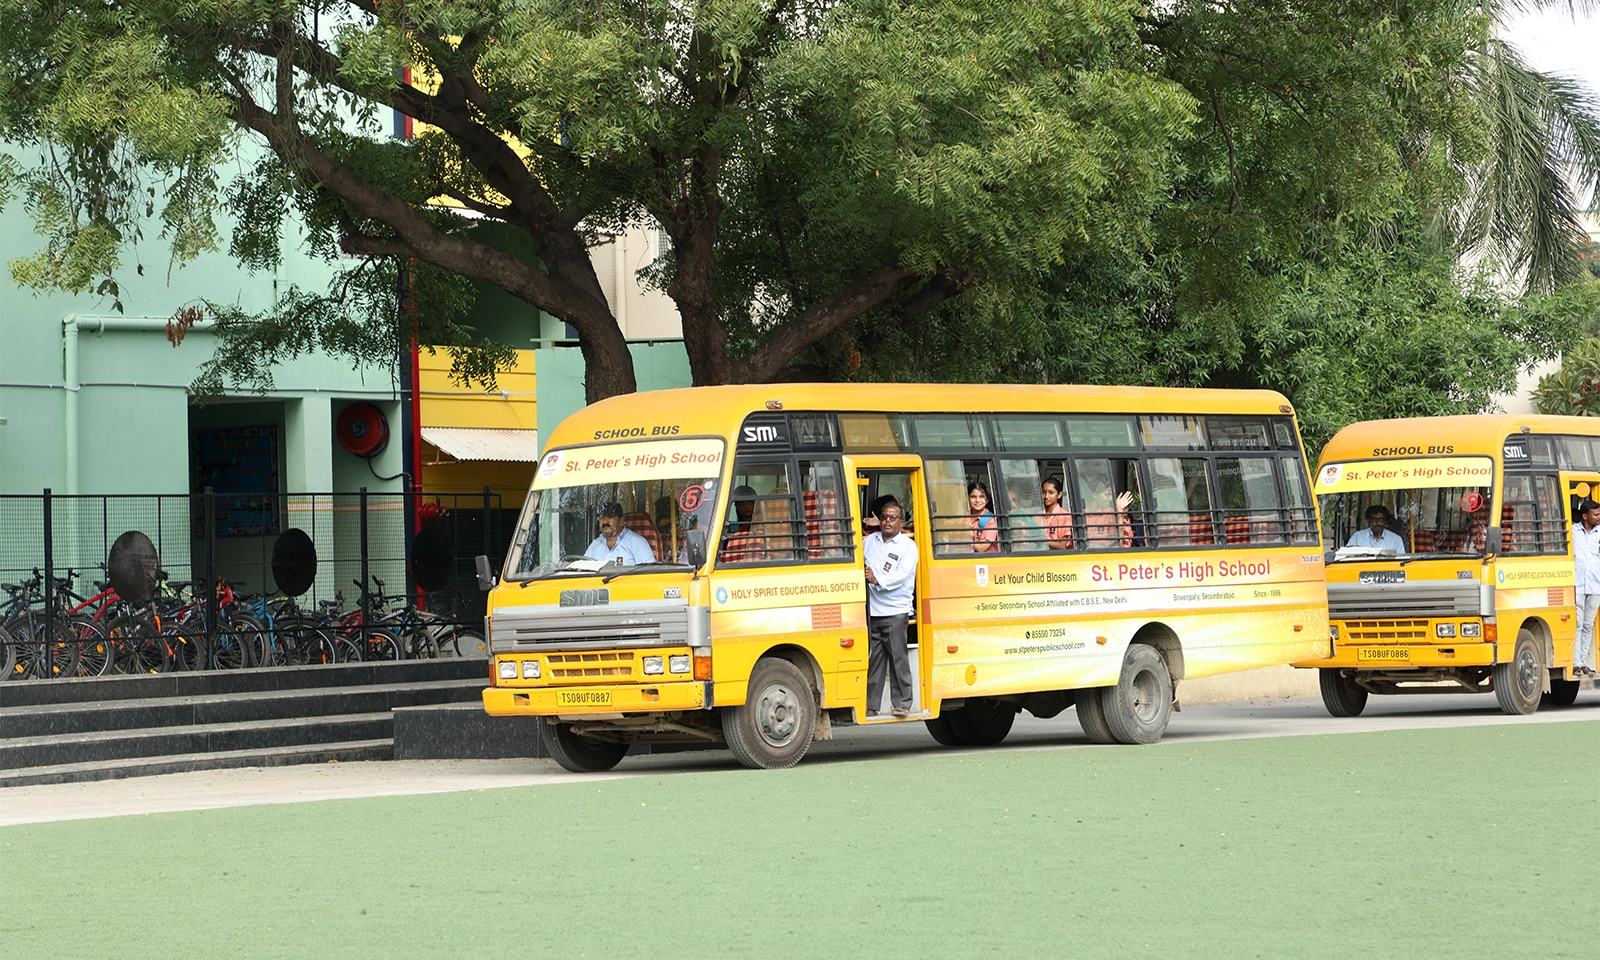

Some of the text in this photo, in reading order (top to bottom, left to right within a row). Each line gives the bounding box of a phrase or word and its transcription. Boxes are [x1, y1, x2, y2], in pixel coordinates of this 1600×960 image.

[594, 426, 680, 440] SCHOOL BUS
[1372, 446, 1454, 456] SCHOOL BUS
[1504, 446, 1528, 458] SML
[565, 460, 582, 472] St.
[635, 454, 666, 468] High
[670, 452, 720, 464] School
[1346, 472, 1362, 481] St.
[1414, 468, 1442, 478] High
[1446, 466, 1492, 476] School
[684, 490, 698, 508] 5
[1467, 495, 1478, 508] 9
[1092, 564, 1112, 582] St.
[1179, 562, 1214, 582] High
[1218, 558, 1270, 576] School
[1518, 572, 1530, 580] SPIRIT
[1531, 571, 1556, 580] EDUCATIONAL
[994, 574, 1006, 584] Let
[1008, 574, 1024, 584] Your
[1026, 572, 1044, 584] Child
[1046, 572, 1077, 582] Blossom
[730, 582, 860, 599] HOLY SPIRIT EDUCATIONAL SOCIETY
[560, 589, 610, 608] SML
[981, 602, 998, 610] Senior
[999, 602, 1026, 610] Secondary
[1028, 600, 1046, 608] School
[1004, 642, 1086, 655] www.stpeterspublicschool.com
[1364, 650, 1408, 658] TS08UF0886
[562, 692, 610, 703] TS08UF0887
